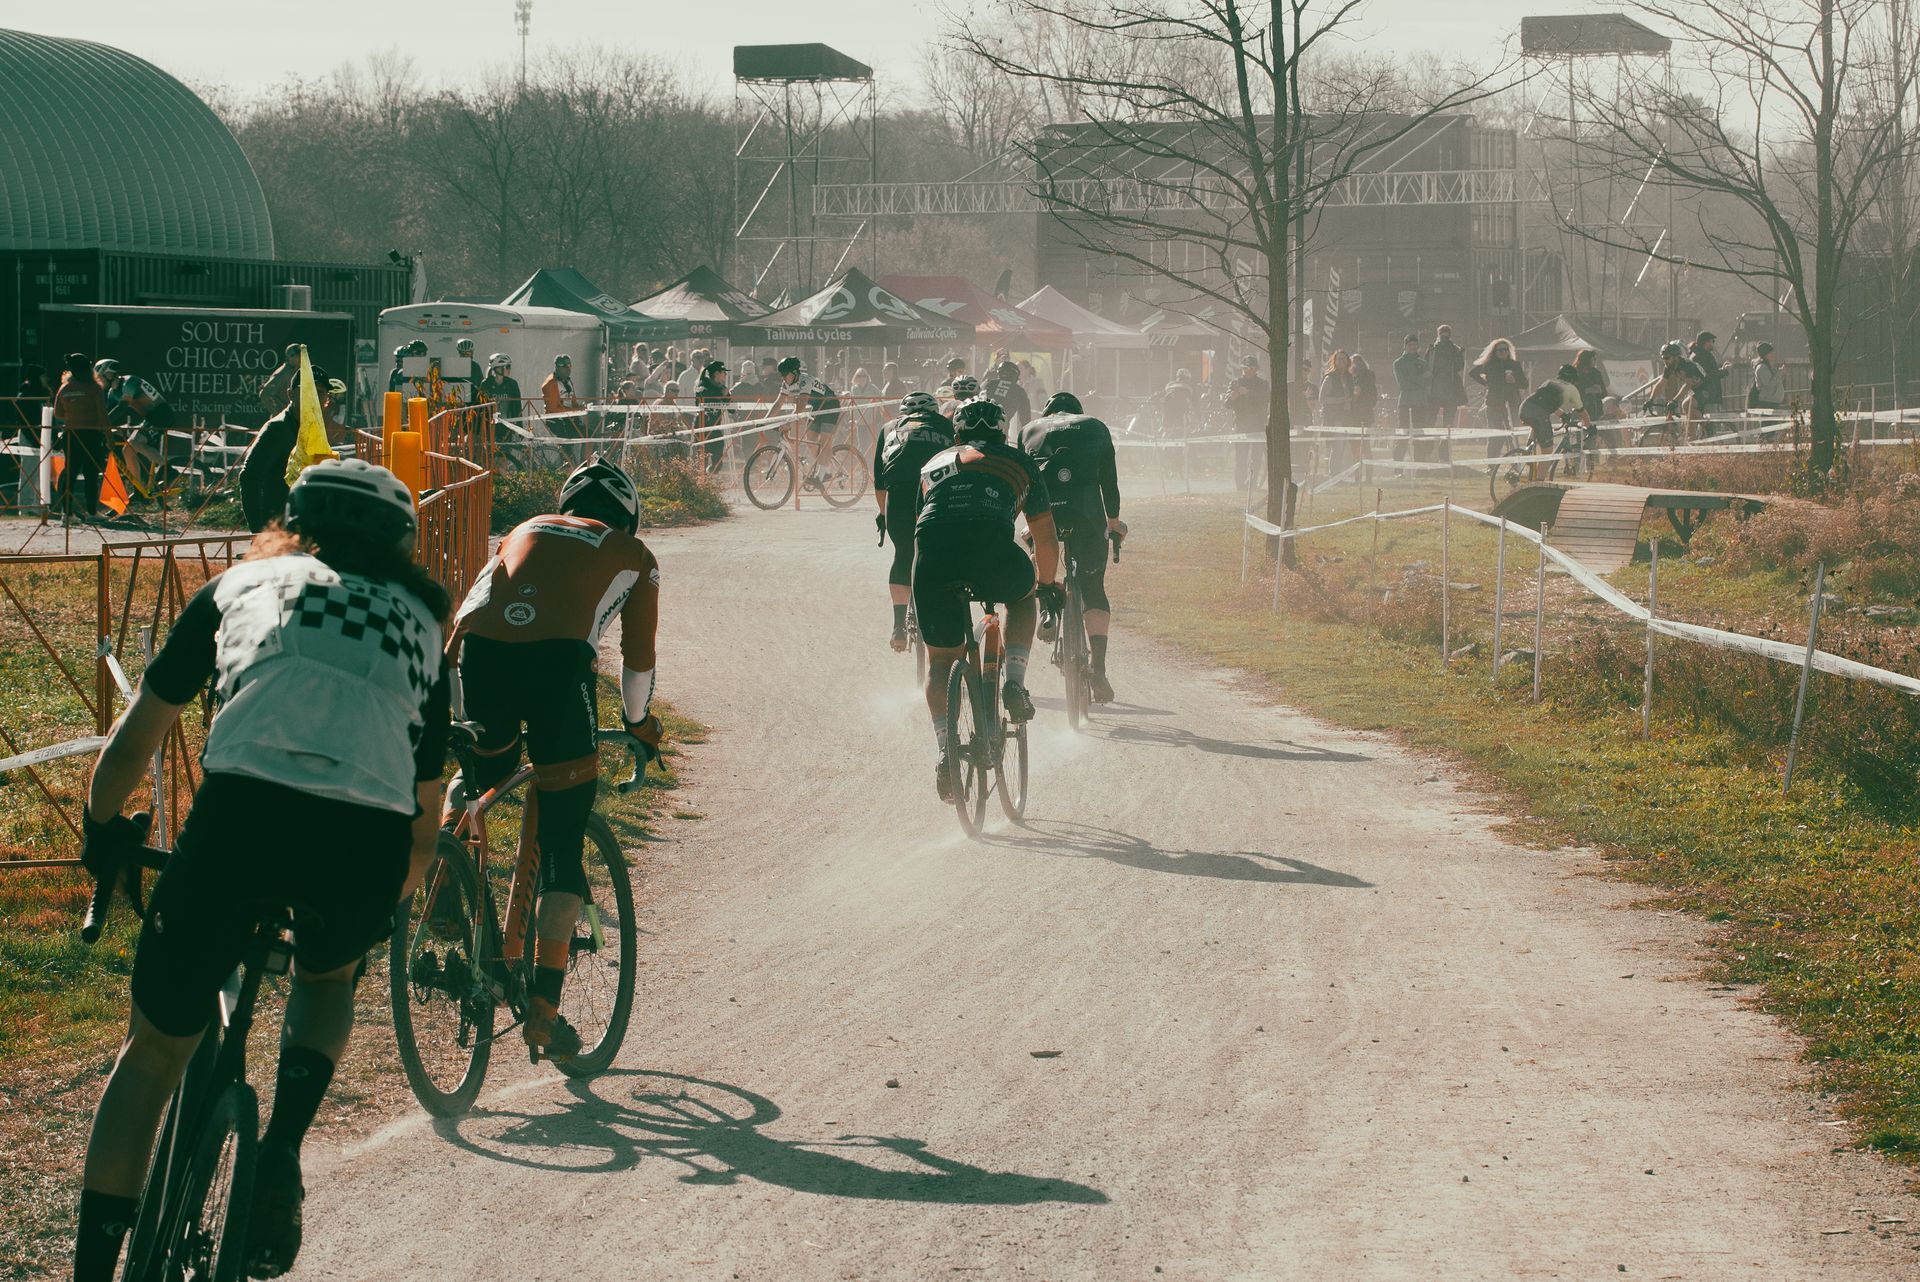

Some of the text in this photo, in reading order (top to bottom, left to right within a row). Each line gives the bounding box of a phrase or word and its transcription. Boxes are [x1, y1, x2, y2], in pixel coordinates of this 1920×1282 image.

[181, 321, 265, 344] SOUTH
[765, 328, 852, 343] Tailwind Cycles
[906, 327, 957, 342] Tailwind Cycles
[166, 347, 279, 370] CHICAGO
[156, 372, 269, 395] WHEELM
[192, 398, 233, 414] Racing
[234, 399, 267, 413] Since
[529, 524, 598, 542] NNELLY
[279, 569, 428, 634] UGEOT
